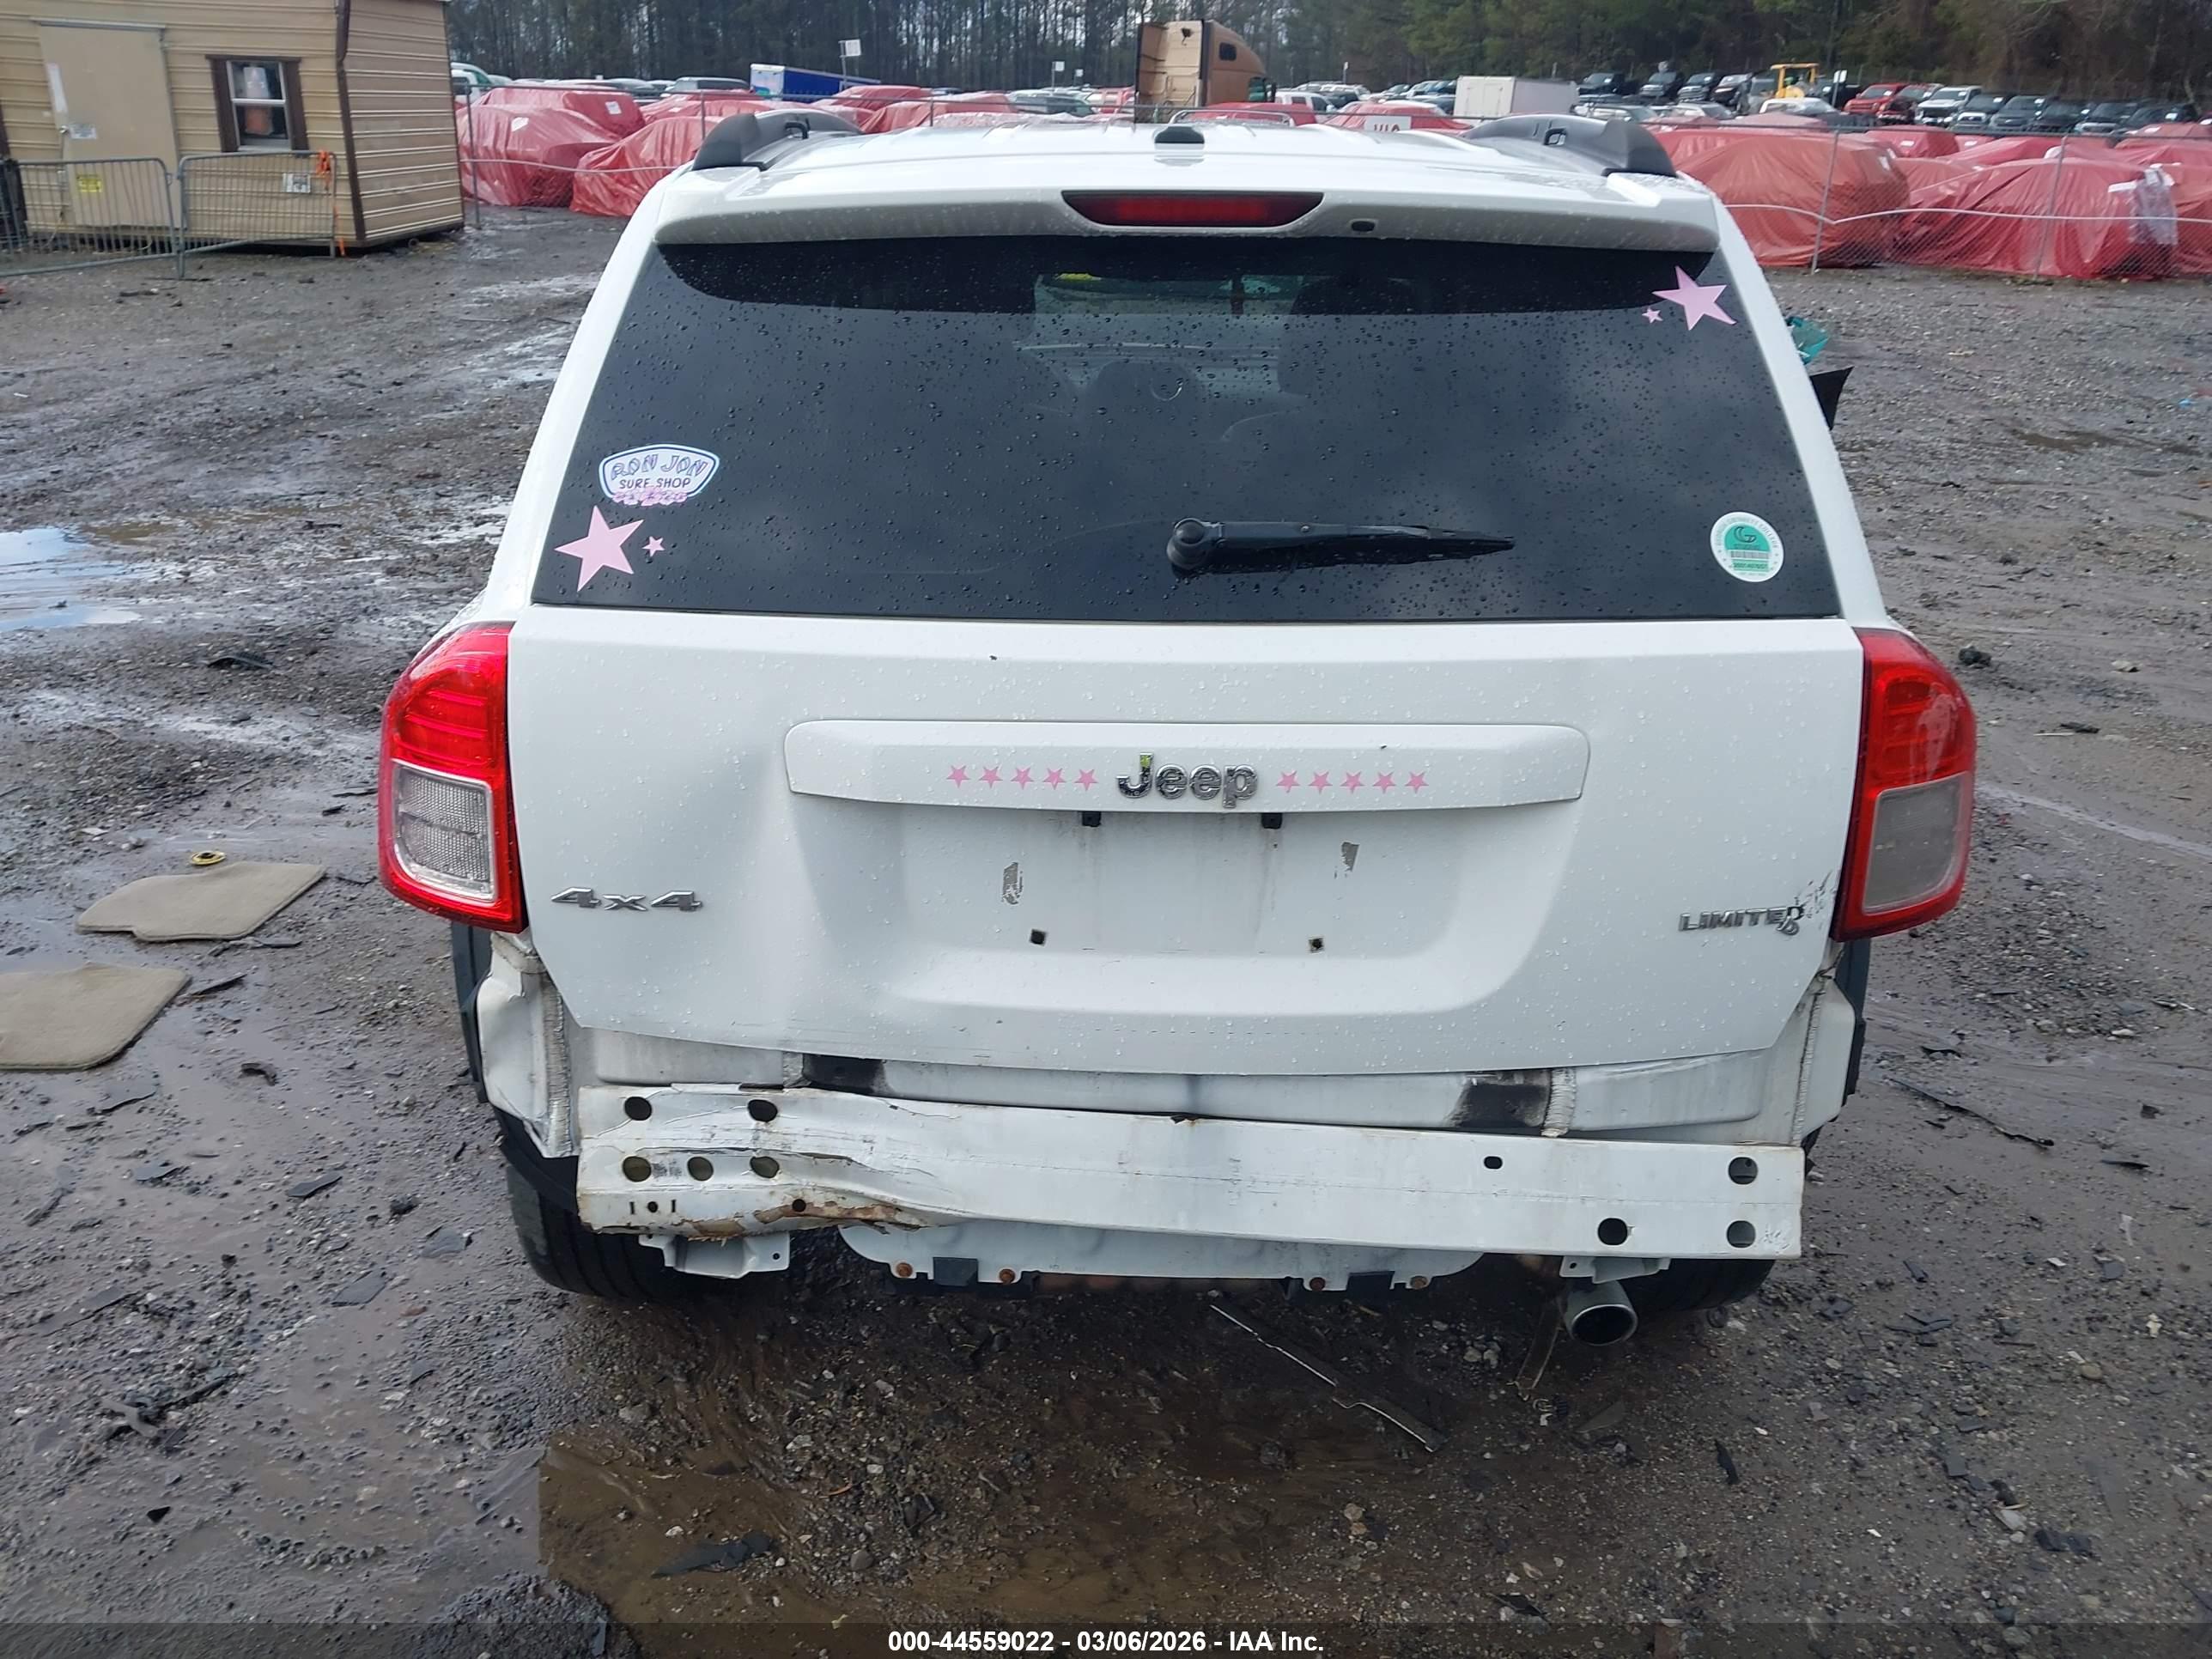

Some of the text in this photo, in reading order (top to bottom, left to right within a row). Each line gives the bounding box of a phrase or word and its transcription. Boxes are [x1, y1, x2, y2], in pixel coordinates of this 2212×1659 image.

[660, 454, 708, 477] JON
[619, 477, 691, 489] SURF SHOP
[1116, 753, 1258, 808] Jeep
